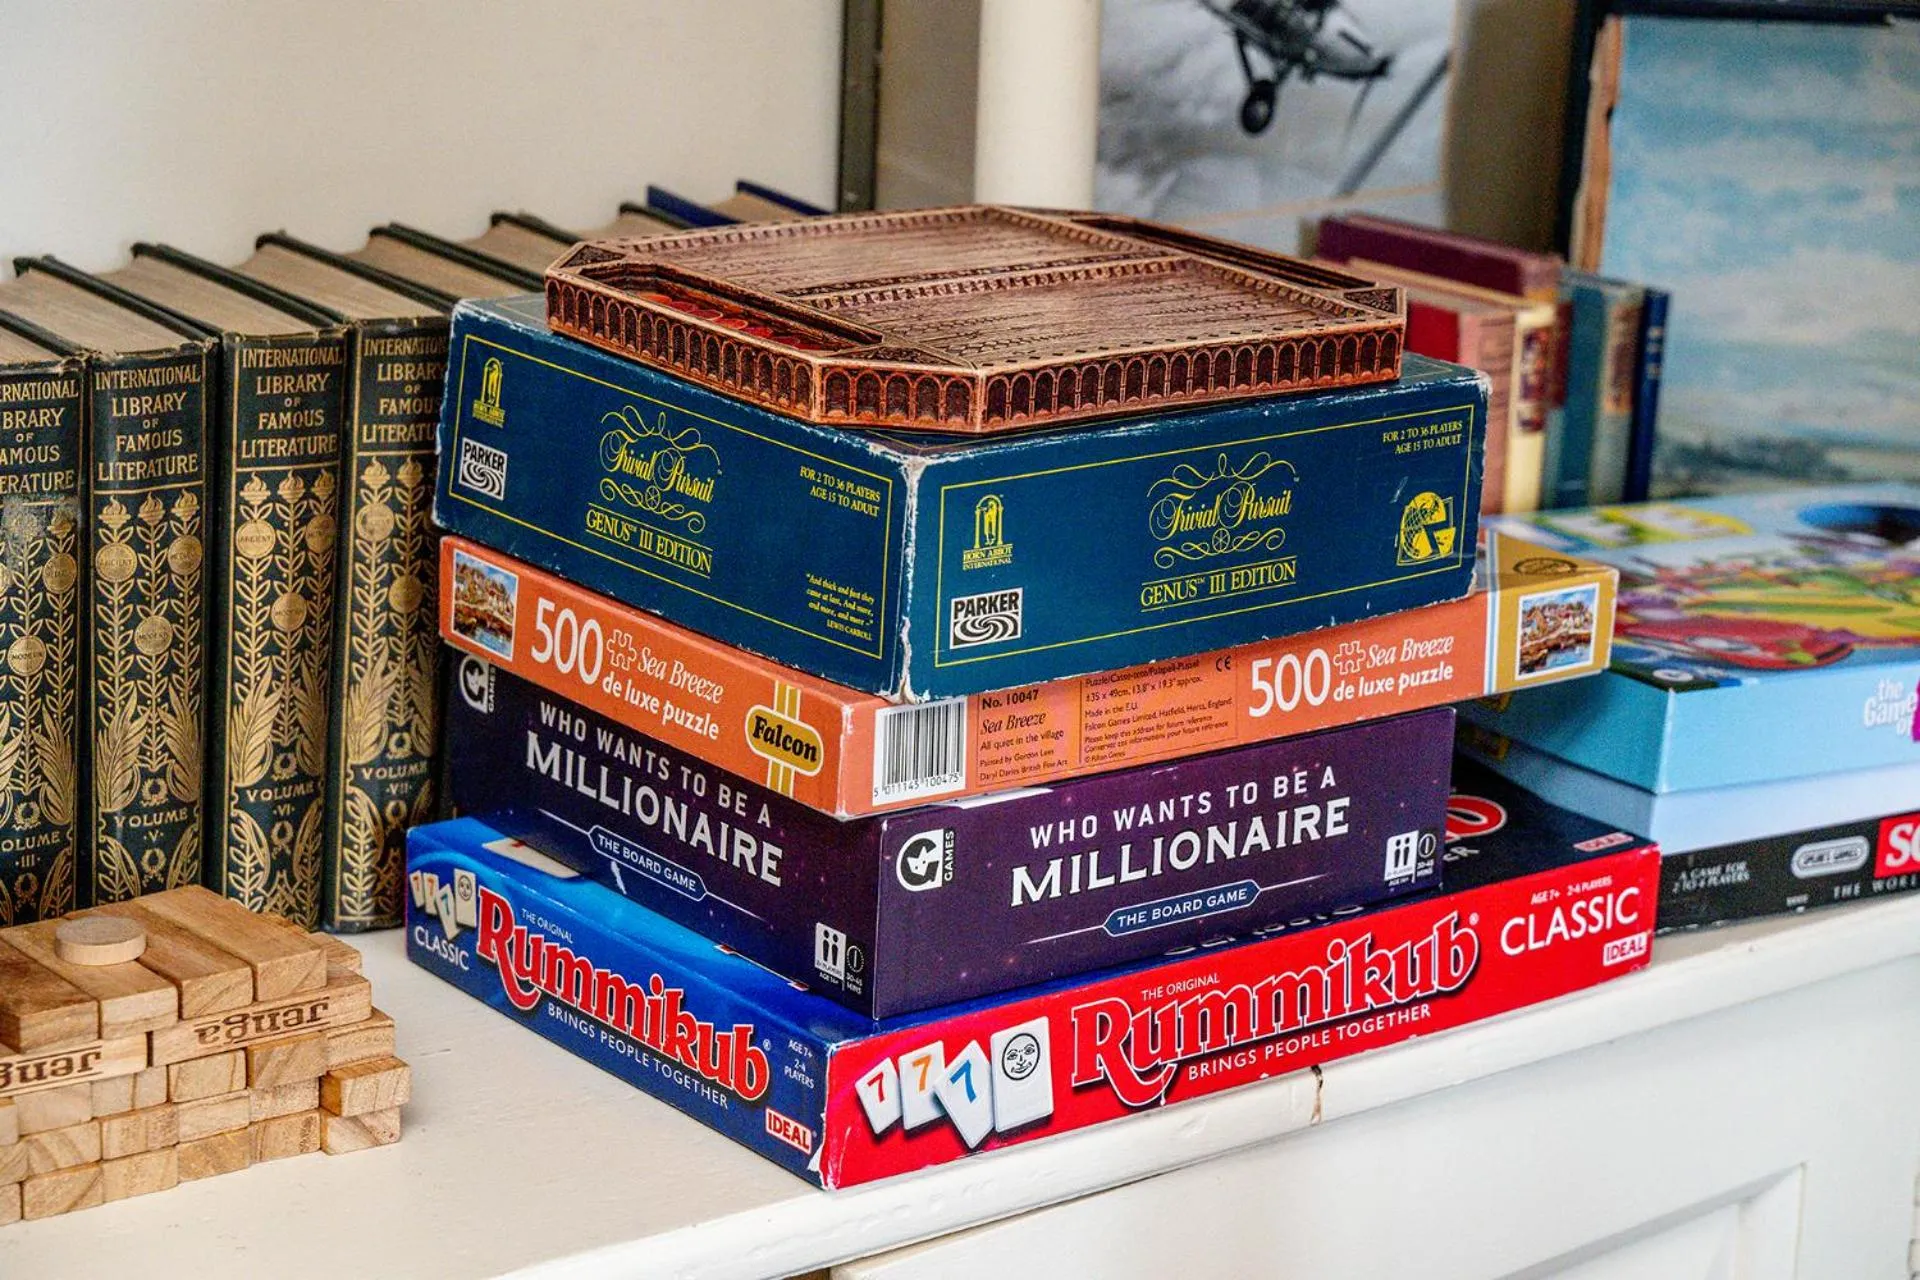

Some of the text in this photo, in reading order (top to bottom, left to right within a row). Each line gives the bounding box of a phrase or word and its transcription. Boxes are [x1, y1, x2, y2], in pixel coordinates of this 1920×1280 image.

[242, 347, 343, 368] INTERNATIONAL
[364, 337, 448, 356] INTERNATION
[0, 380, 79, 402] RNATIONAL
[95, 364, 201, 390] INTERNATIONAL
[256, 372, 331, 395] LIBRARY
[112, 392, 187, 417] LIBRARY
[284, 397, 301, 408] OF
[380, 398, 436, 415] FAMOU
[3, 407, 65, 430] BRARY
[142, 418, 159, 429] OF
[258, 409, 325, 430] FAMOUS
[362, 423, 436, 443] LITERATU
[1383, 431, 1399, 444] FOR
[1406, 428, 1419, 439] TO
[1429, 420, 1463, 435] PLAYERS
[15, 433, 34, 443] OF
[116, 429, 183, 453] FAMOUS
[241, 434, 337, 459] LITERATURE
[1395, 442, 1412, 454] AGE
[1423, 439, 1434, 450] TO
[1435, 434, 1462, 447] ADULT
[0, 444, 61, 466] AMOUS
[98, 453, 198, 481] LITERATURE
[463, 441, 505, 473] PARKER
[600, 429, 715, 503] Trivial Pursuit
[0, 470, 75, 494] ERATURE
[800, 466, 816, 481] FOR
[823, 473, 835, 488] TO
[846, 481, 881, 503] PLAYERS
[810, 486, 880, 517] AGE 15 TO ADULT
[1149, 480, 1292, 541] Trivial Pursuit
[639, 529, 653, 551] III
[657, 534, 713, 573] EDITION
[1209, 573, 1226, 594] III
[1231, 560, 1297, 591] EDITION
[954, 591, 1020, 620] PARKER
[531, 597, 603, 686] 500
[1366, 635, 1454, 669] Sea Breeze
[488, 667, 496, 713] GAMES
[638, 648, 724, 704] Sea Breeze
[1249, 647, 1331, 718] 500
[1333, 660, 1454, 702] de luxe puzzle
[602, 671, 720, 740] de luxe puzzle
[982, 689, 1039, 710] No. 10047
[980, 712, 1047, 735] Sea Breeze
[752, 714, 819, 764] Falcon
[980, 741, 991, 751] All
[1026, 733, 1038, 743] the
[1041, 729, 1064, 740] village
[362, 761, 427, 780] VOLUME
[540, 701, 772, 828] WHO WANTS TO BE A
[246, 781, 314, 803] VOLUME
[873, 788, 879, 798] 5
[114, 807, 188, 828] VOLUME
[526, 729, 783, 887] MILLIONAIRE
[1030, 765, 1338, 851] WHO WANTS TO BE A
[1, 831, 60, 852] OLUME
[944, 831, 955, 881] GAMES
[1011, 796, 1352, 909] MILLIONAIRE
[598, 833, 696, 892] THE BOARD GAME
[1531, 890, 1548, 905] AGE
[1871, 872, 1917, 893] WORL
[1117, 887, 1248, 928] THE BOARD GAME
[1500, 886, 1640, 956] CLASSIC
[521, 907, 574, 944] THE ORIGINAL
[415, 925, 470, 970] CLASSIC
[1605, 935, 1644, 963] IDEAL
[476, 886, 770, 1102] Rummikub
[1142, 971, 1221, 1001] THE ORIGINAL
[197, 1001, 329, 1046] Jenga
[1070, 910, 1480, 1107] Rummikub
[547, 1001, 729, 1110] BRINGS PEOPLE TOGETHER
[788, 1040, 803, 1055] AGE
[1188, 1002, 1432, 1082] BRINGS PEOPLE TOGETHER
[784, 1065, 815, 1090] PLAYERS
[867, 1071, 886, 1104] 7
[911, 1054, 933, 1094] 7
[949, 1058, 978, 1104] 7
[767, 1111, 810, 1150] IDEAL
